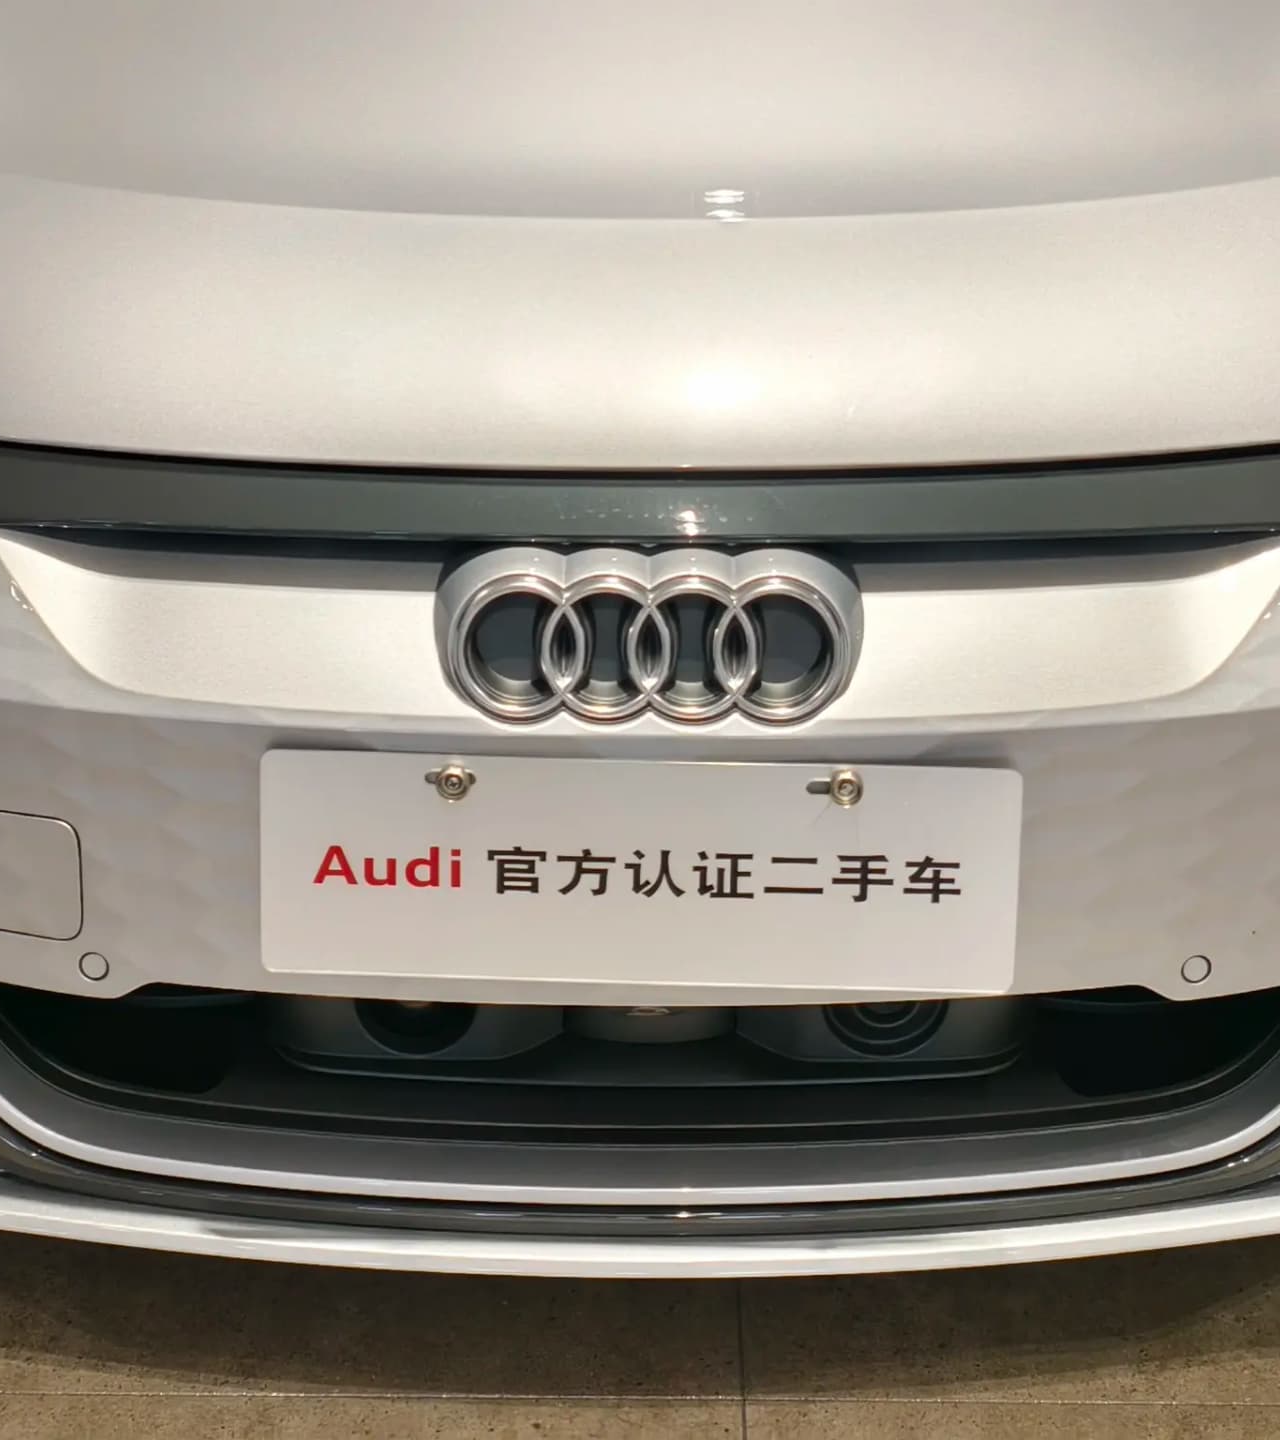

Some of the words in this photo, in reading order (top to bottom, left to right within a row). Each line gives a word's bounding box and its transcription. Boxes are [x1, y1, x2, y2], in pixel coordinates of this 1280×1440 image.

[313, 845, 462, 889] Audi
[487, 846, 962, 904] 官方认证二手车
